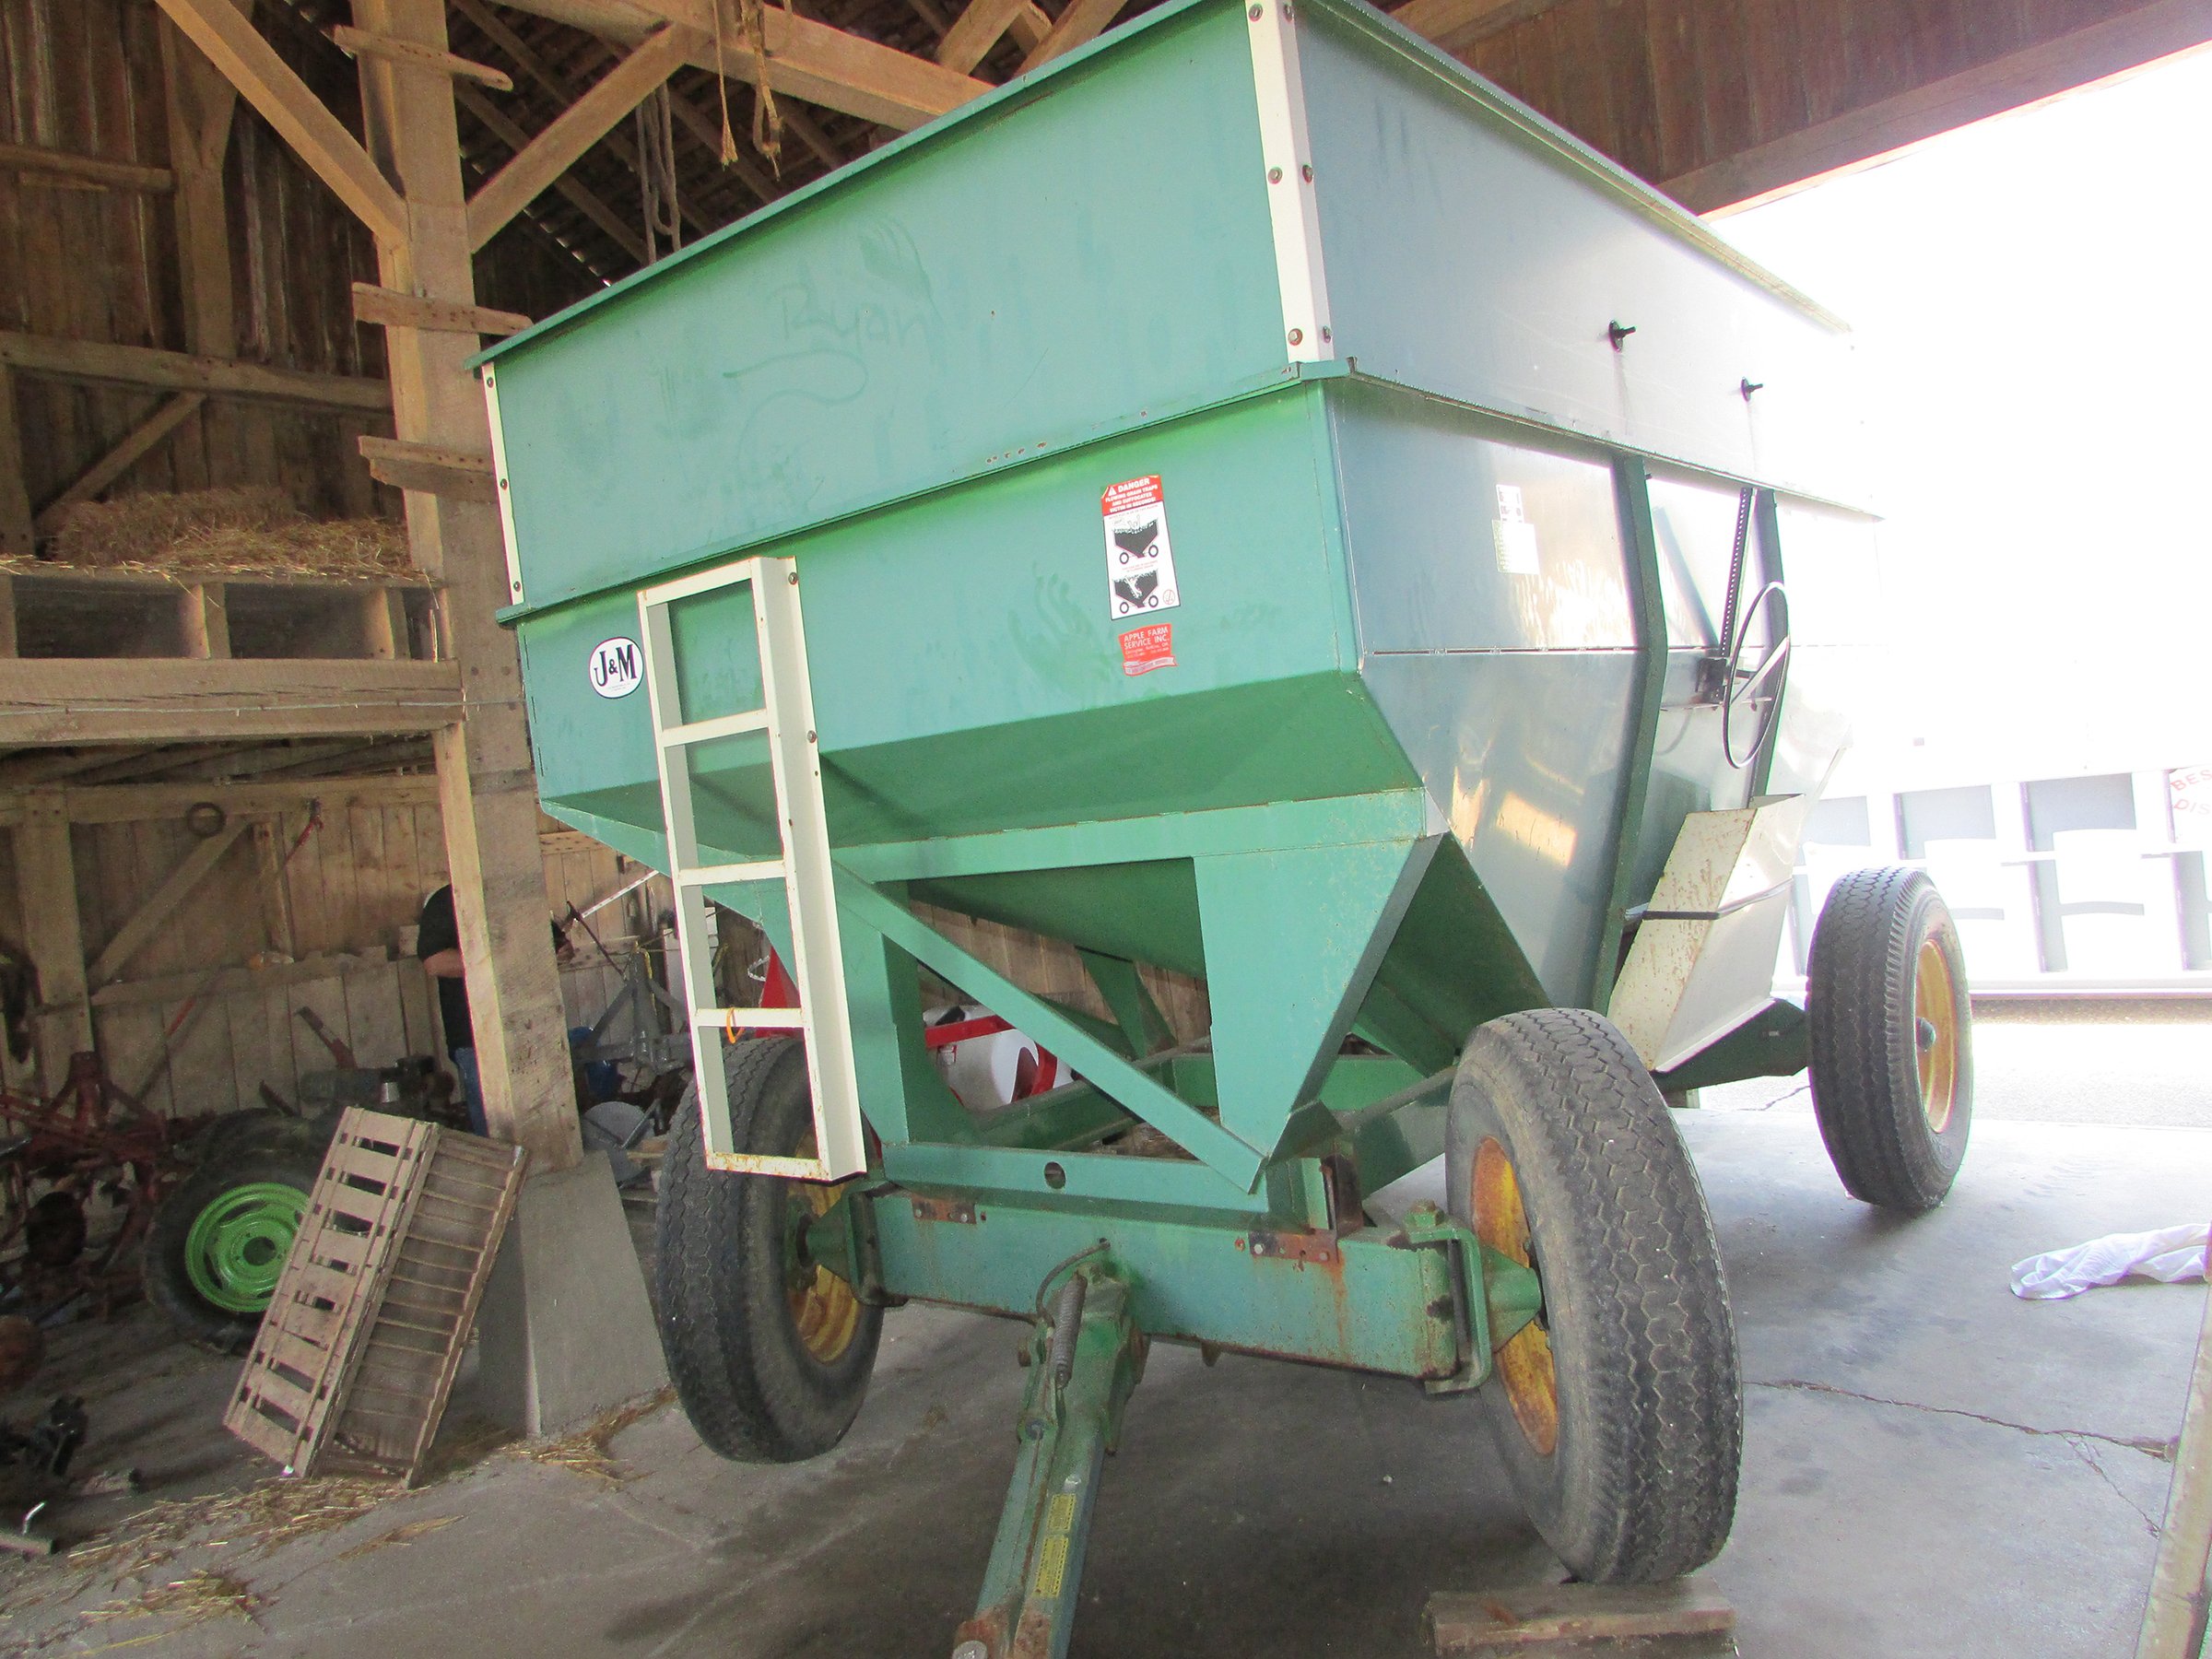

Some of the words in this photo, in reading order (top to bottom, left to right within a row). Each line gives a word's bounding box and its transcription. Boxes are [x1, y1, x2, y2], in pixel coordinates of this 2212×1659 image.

[1118, 478, 1150, 492] DANGER
[1105, 493, 1126, 502] FLOWING
[1126, 488, 1143, 498] GRAIN
[1142, 485, 1159, 493] TRAPS
[1123, 492, 1152, 504] SUFFOCATES
[1124, 631, 1145, 641] APPLE
[1147, 627, 1169, 637] FARM
[1124, 637, 1151, 650] SERVICE
[1154, 634, 1170, 643] INC.
[594, 643, 638, 688] J&M
